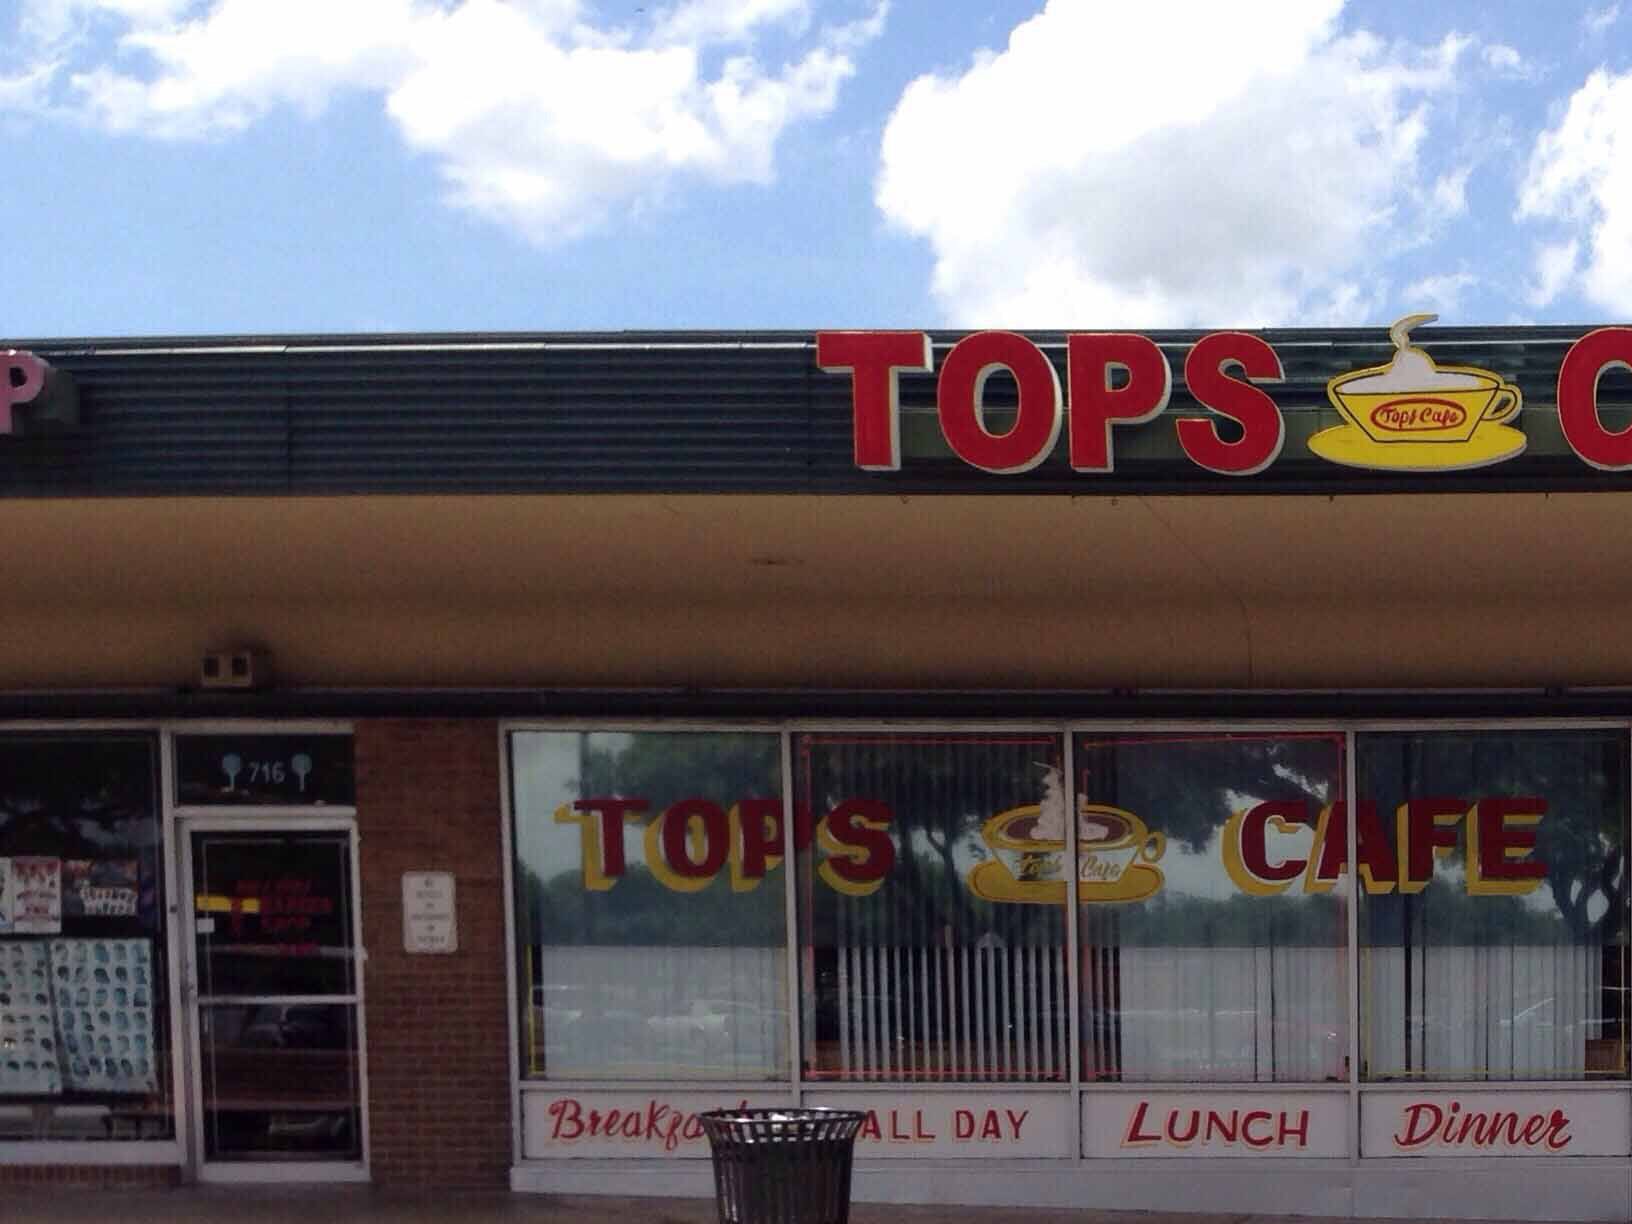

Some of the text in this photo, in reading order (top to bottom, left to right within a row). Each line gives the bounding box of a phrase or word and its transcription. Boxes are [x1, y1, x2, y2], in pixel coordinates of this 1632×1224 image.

[816, 330, 1285, 475] TOPS
[1419, 405, 1458, 426] Cafe
[250, 762, 285, 783] 716
[1222, 797, 1549, 896] CAFE
[549, 1099, 1030, 1151] Breakfa ALL DAY
[1121, 1101, 1310, 1148] LUNCH
[1394, 1101, 1573, 1150] Dinner
